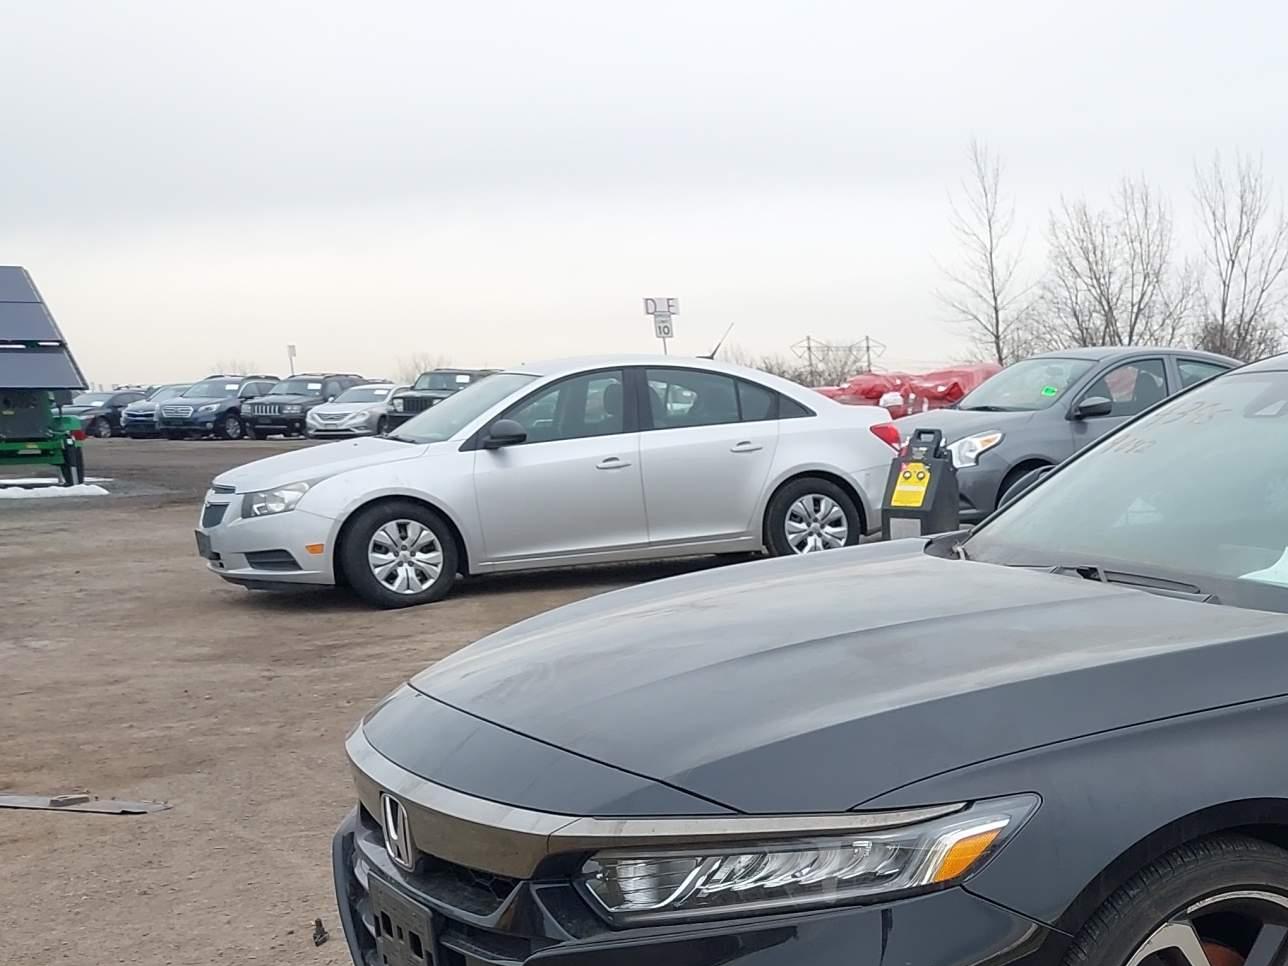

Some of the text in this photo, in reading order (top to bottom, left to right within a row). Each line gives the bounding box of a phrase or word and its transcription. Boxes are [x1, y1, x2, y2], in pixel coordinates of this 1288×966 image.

[645, 298, 679, 315] D E
[658, 325, 670, 336] 10
